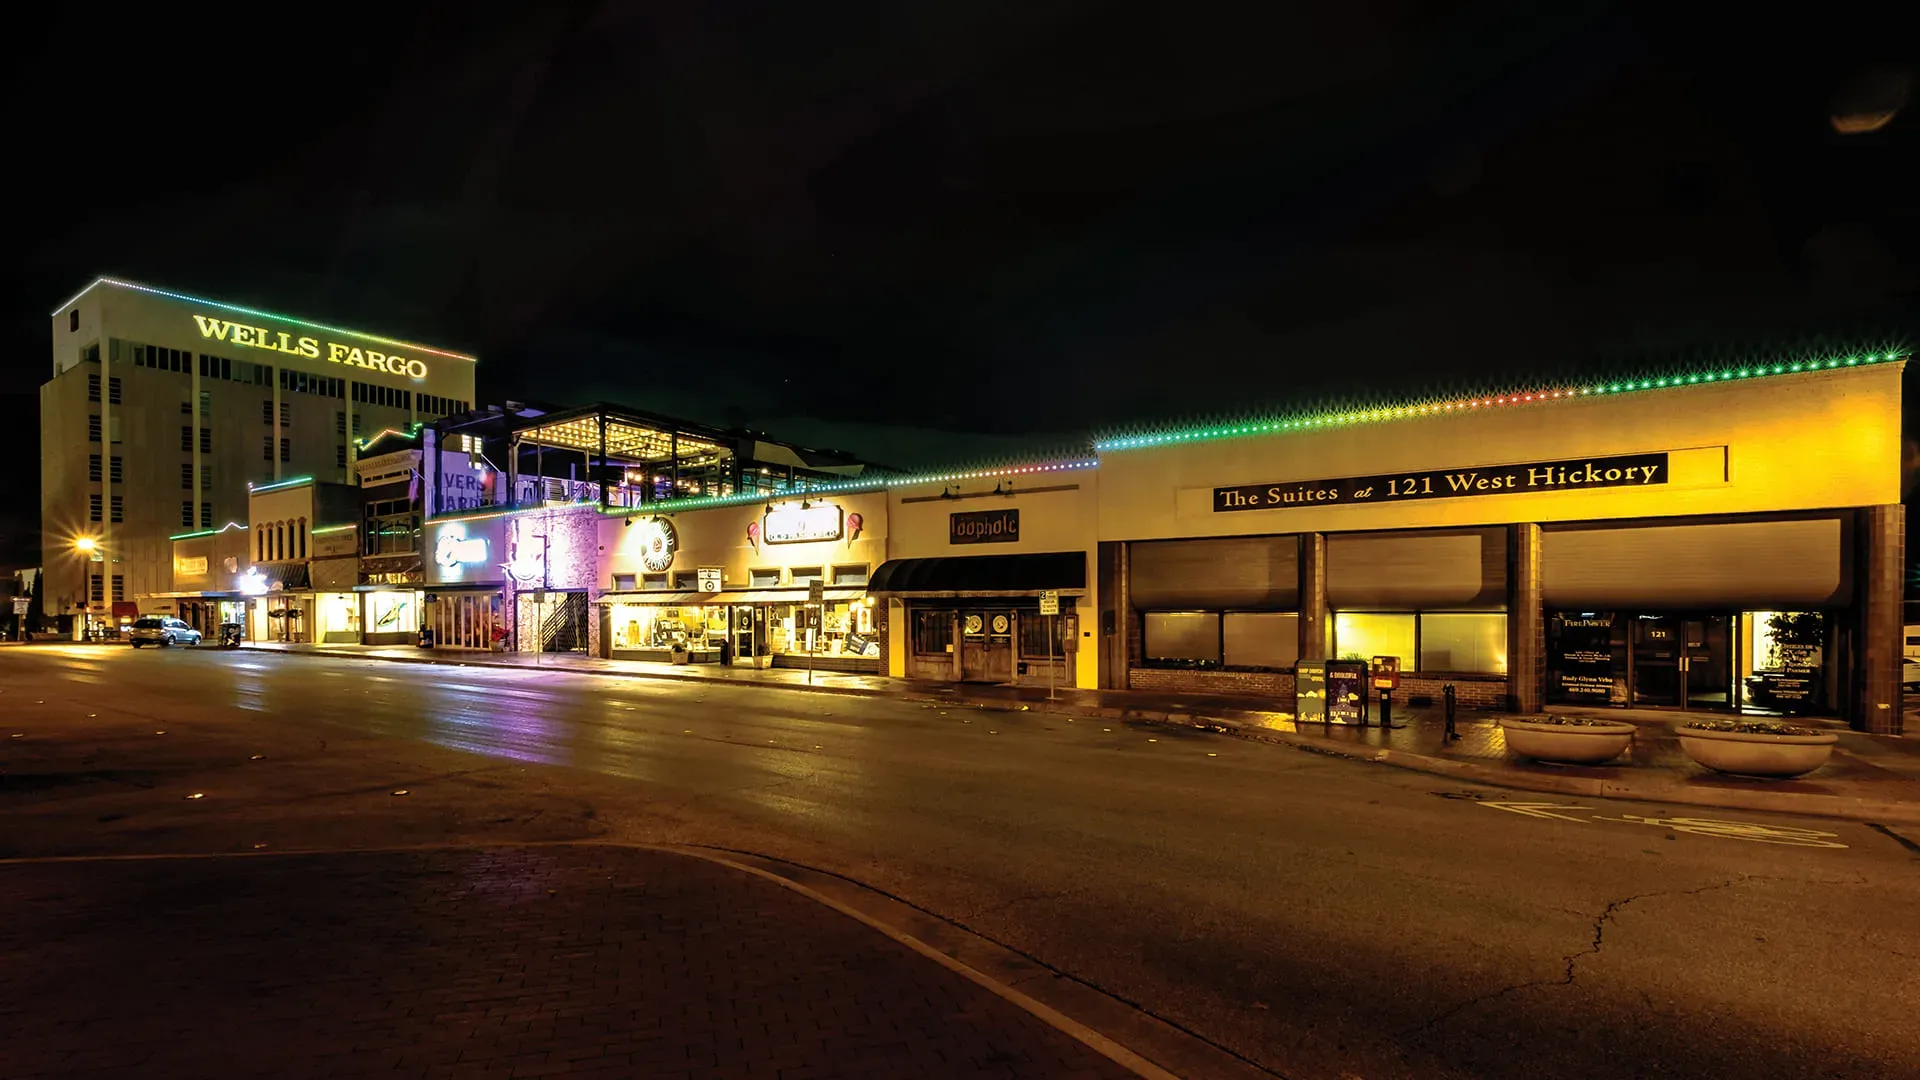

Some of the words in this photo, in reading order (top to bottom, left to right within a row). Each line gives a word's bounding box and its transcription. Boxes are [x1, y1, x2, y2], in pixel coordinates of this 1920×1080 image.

[193, 315, 320, 358] WELLS
[327, 342, 428, 378] FARGO
[1220, 490, 1259, 507] The
[1267, 486, 1339, 505] Suites
[1353, 486, 1374, 499] at
[1387, 476, 1434, 496] 121
[1445, 472, 1517, 492] West
[1527, 463, 1659, 487] Hickory
